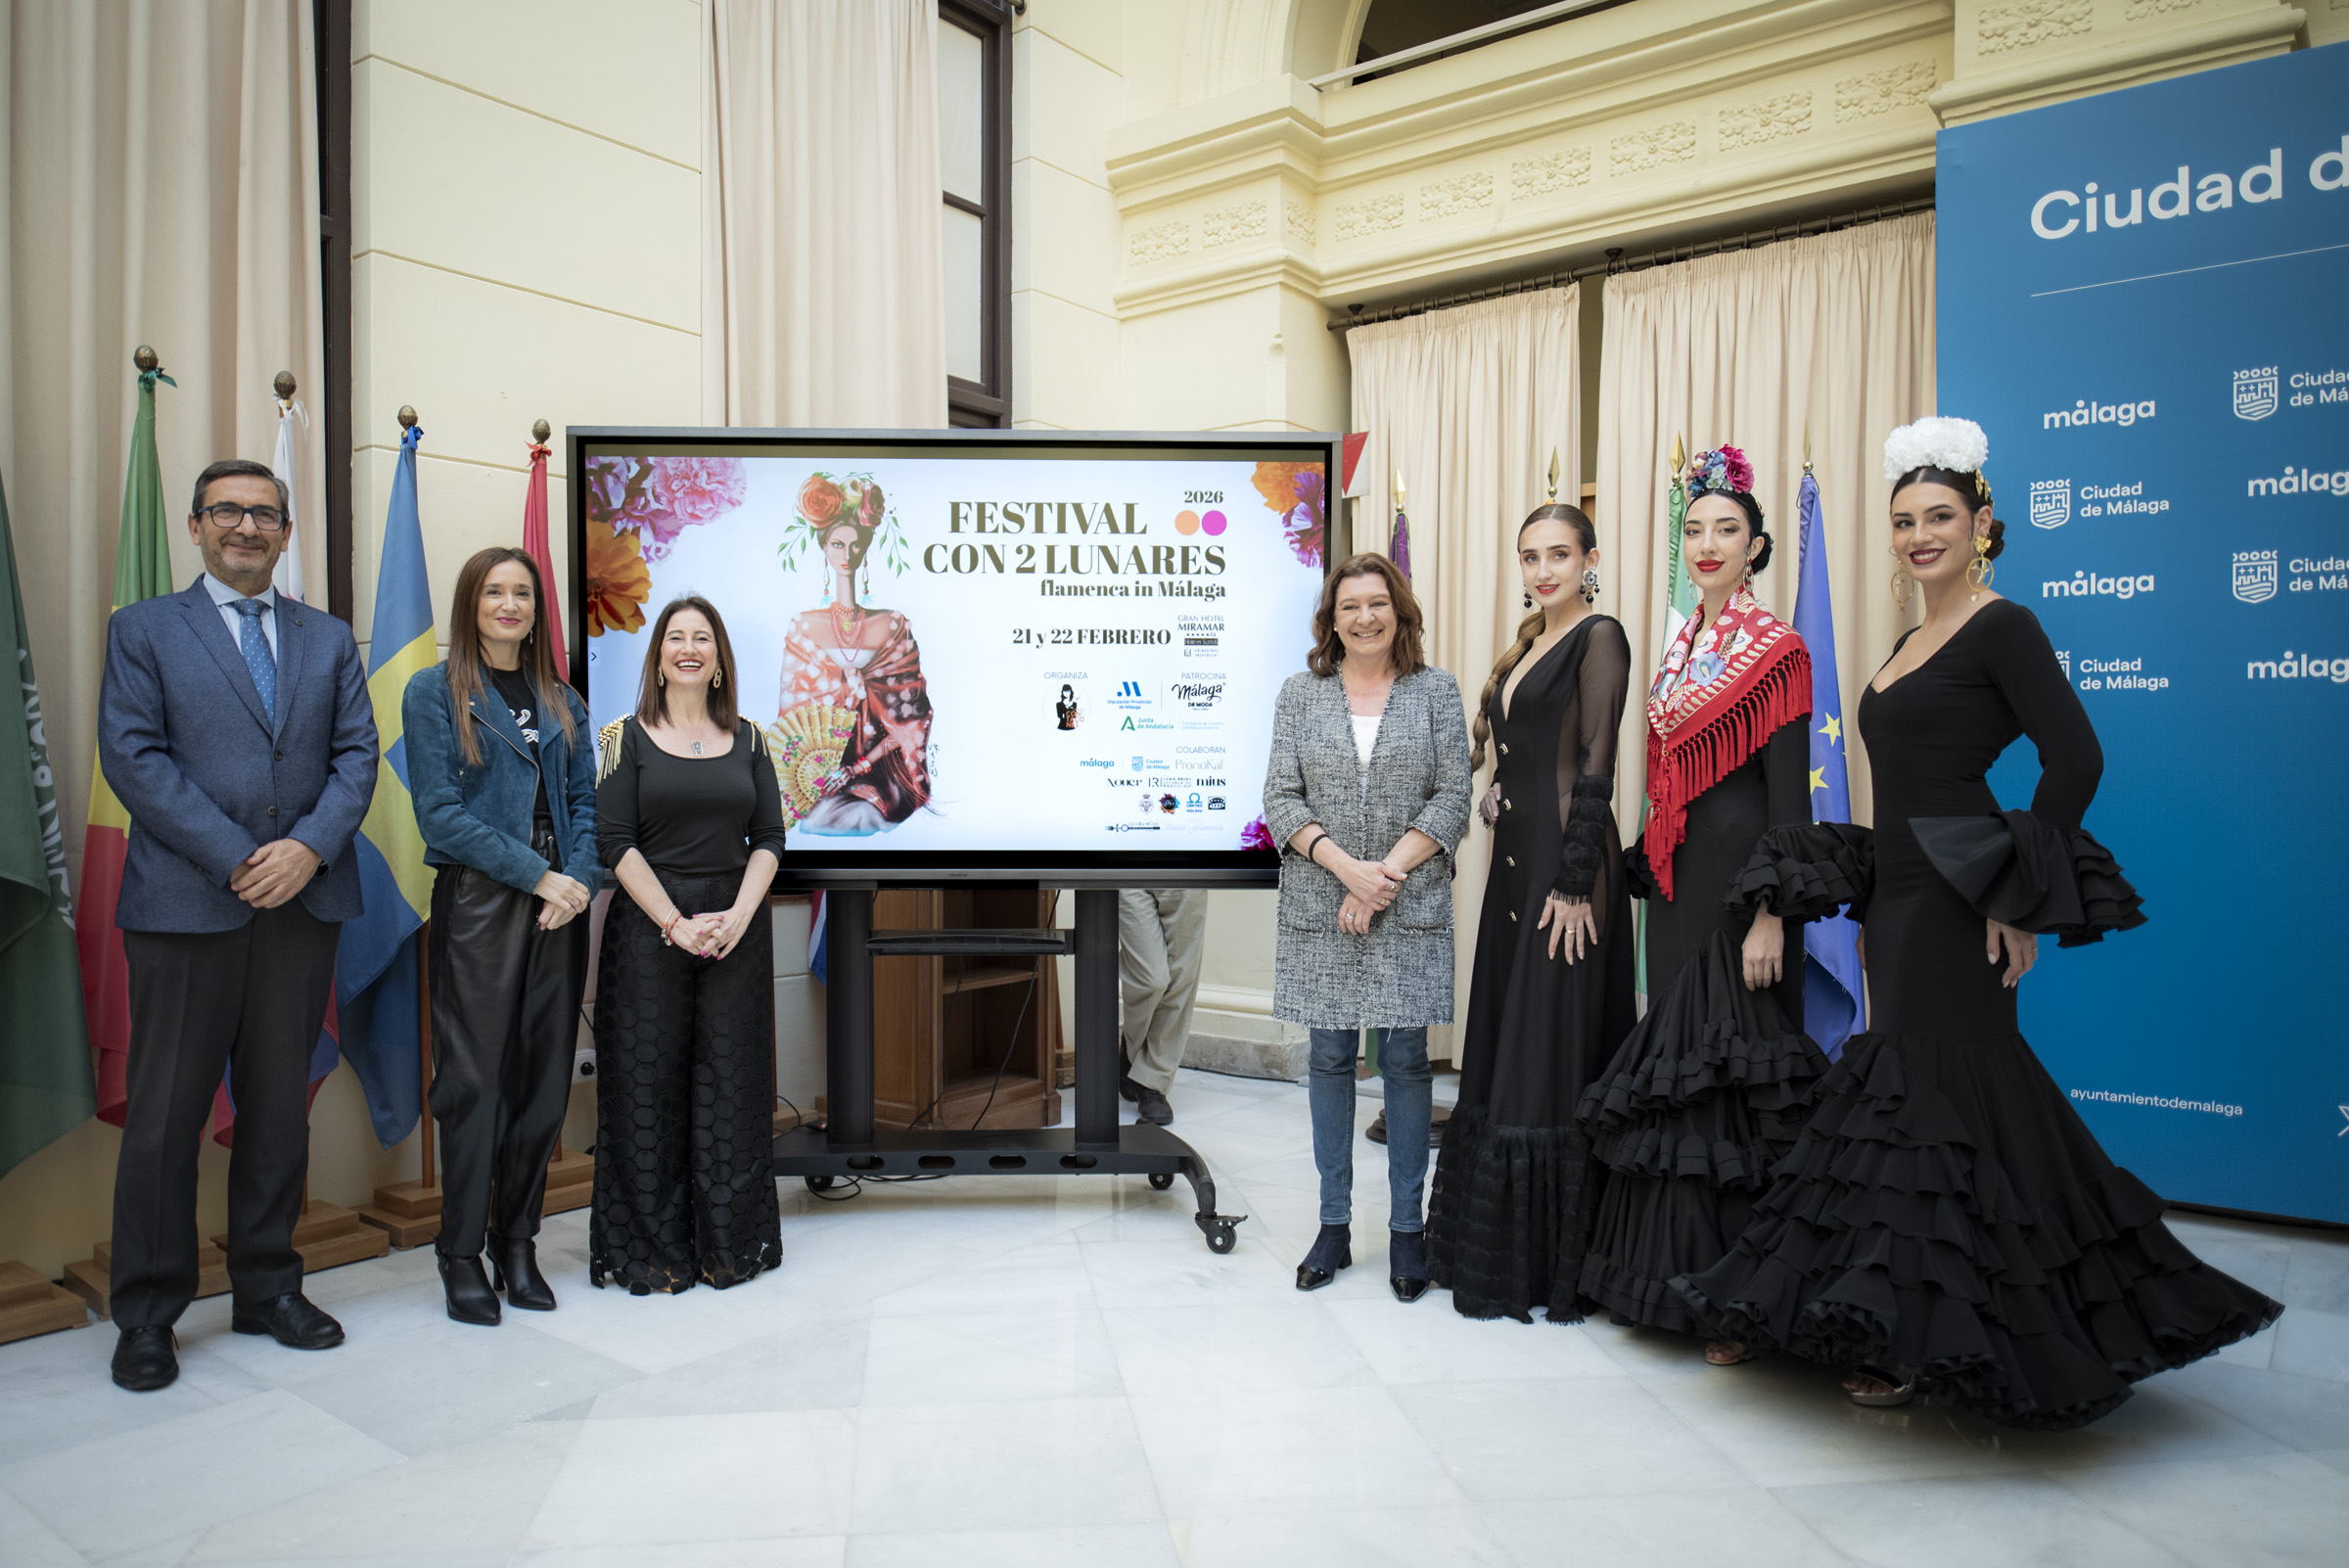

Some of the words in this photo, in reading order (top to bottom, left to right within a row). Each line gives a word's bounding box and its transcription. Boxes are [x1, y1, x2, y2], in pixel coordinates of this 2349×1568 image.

[2031, 148, 2282, 240] Ciudad
[2289, 369, 2349, 388] Ciuda
[2289, 392, 2314, 406] de
[1183, 490, 1224, 504] 2026
[2080, 481, 2142, 500] Ciudad
[2080, 504, 2102, 517] de
[2107, 499, 2170, 515] Málaga
[948, 501, 1148, 534] FESTIVAL
[923, 543, 1007, 575] CON
[1016, 544, 1036, 575] 2
[1045, 544, 1226, 576] LUNARES
[2288, 556, 2349, 574] Ciuda
[1040, 579, 1129, 597] flamenca
[1134, 580, 1154, 597] in
[1158, 580, 1226, 602] Málaga
[2288, 577, 2314, 591] de
[1177, 623, 1225, 631] MIRAMAR
[1012, 628, 1032, 645] 21
[1036, 632, 1047, 649] y
[1050, 628, 1074, 645] 22
[1077, 628, 1172, 645] FEBRERO
[2080, 658, 2142, 672] Ciudad
[1043, 671, 1088, 680] ORGANIZA
[2080, 677, 2102, 690] de
[2106, 675, 2169, 691] Málaga
[1172, 683, 1222, 703] Málaga
[1175, 759, 1223, 770] PronoKal
[1196, 776, 1226, 787] mius
[2070, 1087, 2243, 1117] ayuntamientodemalaga
